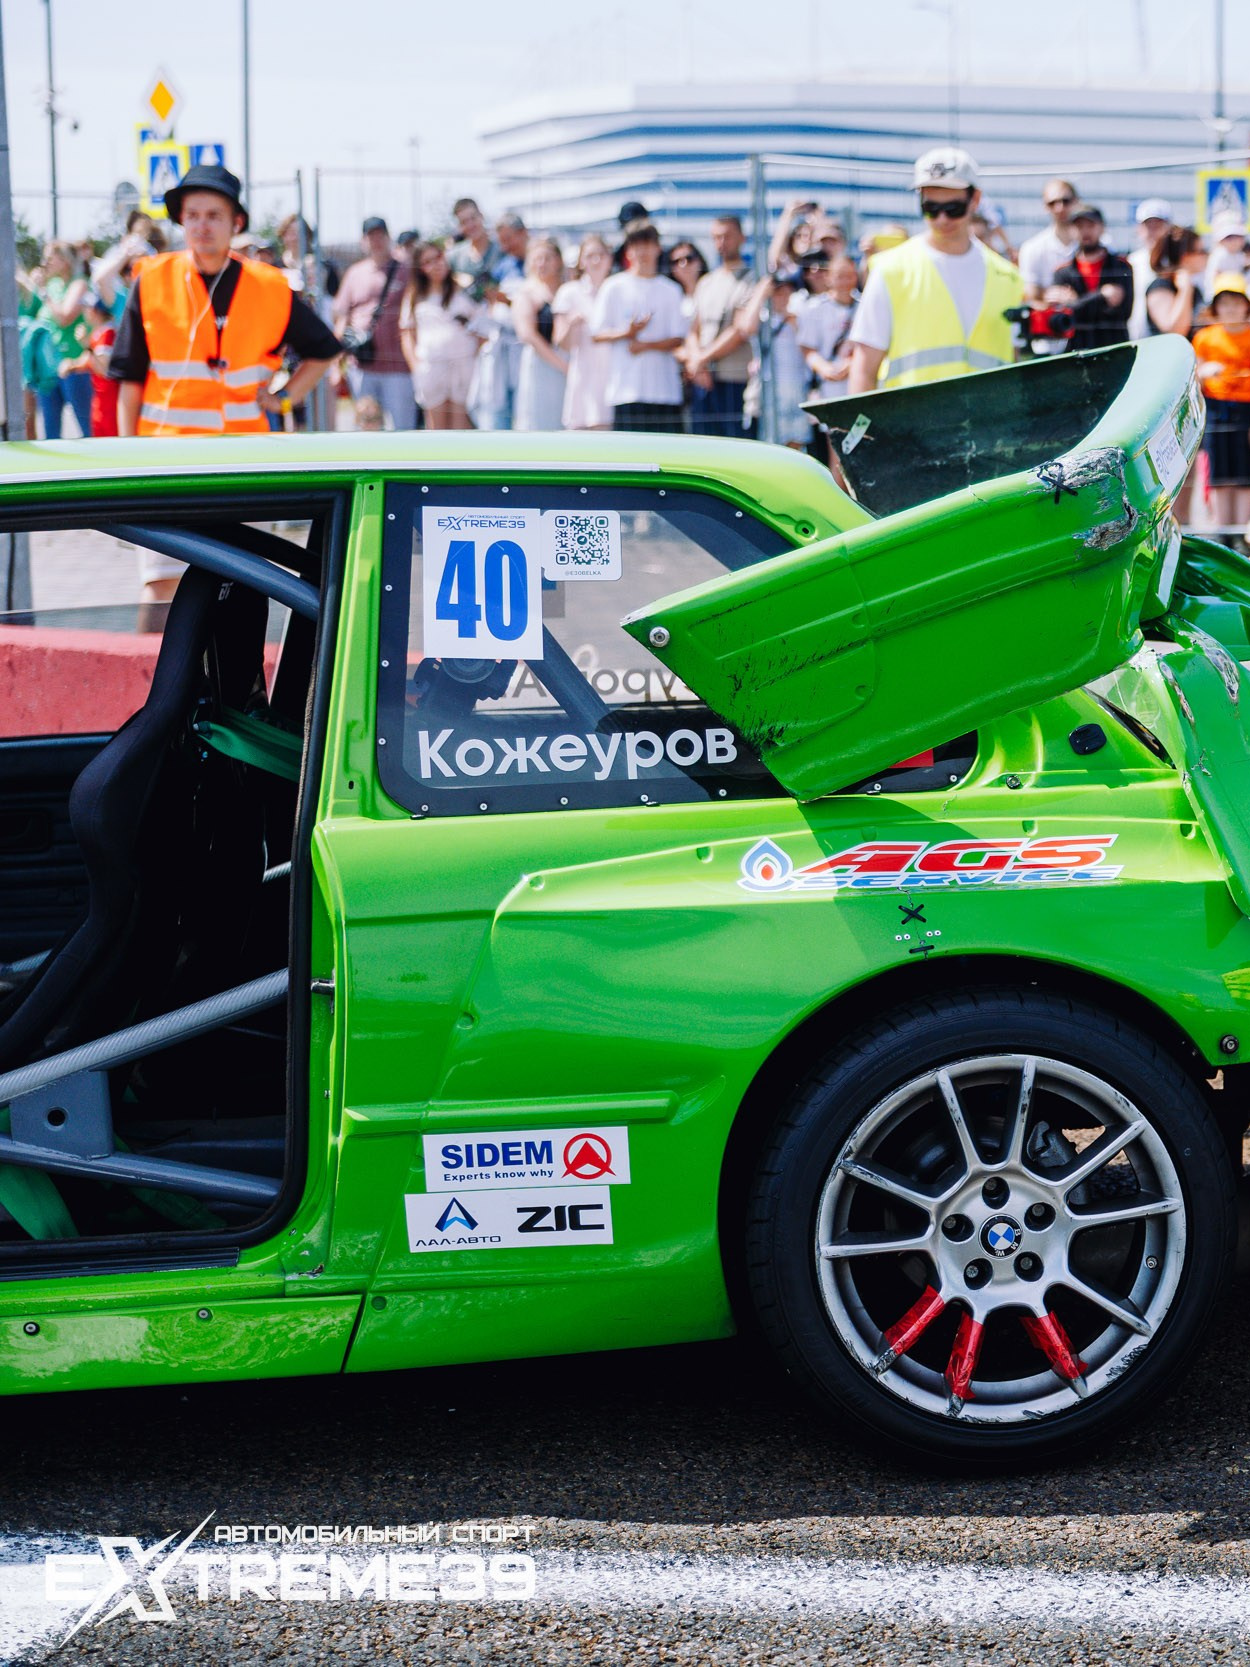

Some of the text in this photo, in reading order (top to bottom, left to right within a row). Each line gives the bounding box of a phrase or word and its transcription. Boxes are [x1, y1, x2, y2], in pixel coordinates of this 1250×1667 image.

[438, 514, 526, 535] EXTREME39
[435, 540, 528, 641] 40
[417, 728, 738, 781] Кожеуров
[793, 834, 1119, 873] AGS
[789, 865, 1124, 890] SERVICE
[441, 1140, 553, 1169] SIDEM
[443, 1169, 554, 1182] Experts know why
[517, 1204, 605, 1233] ZIC
